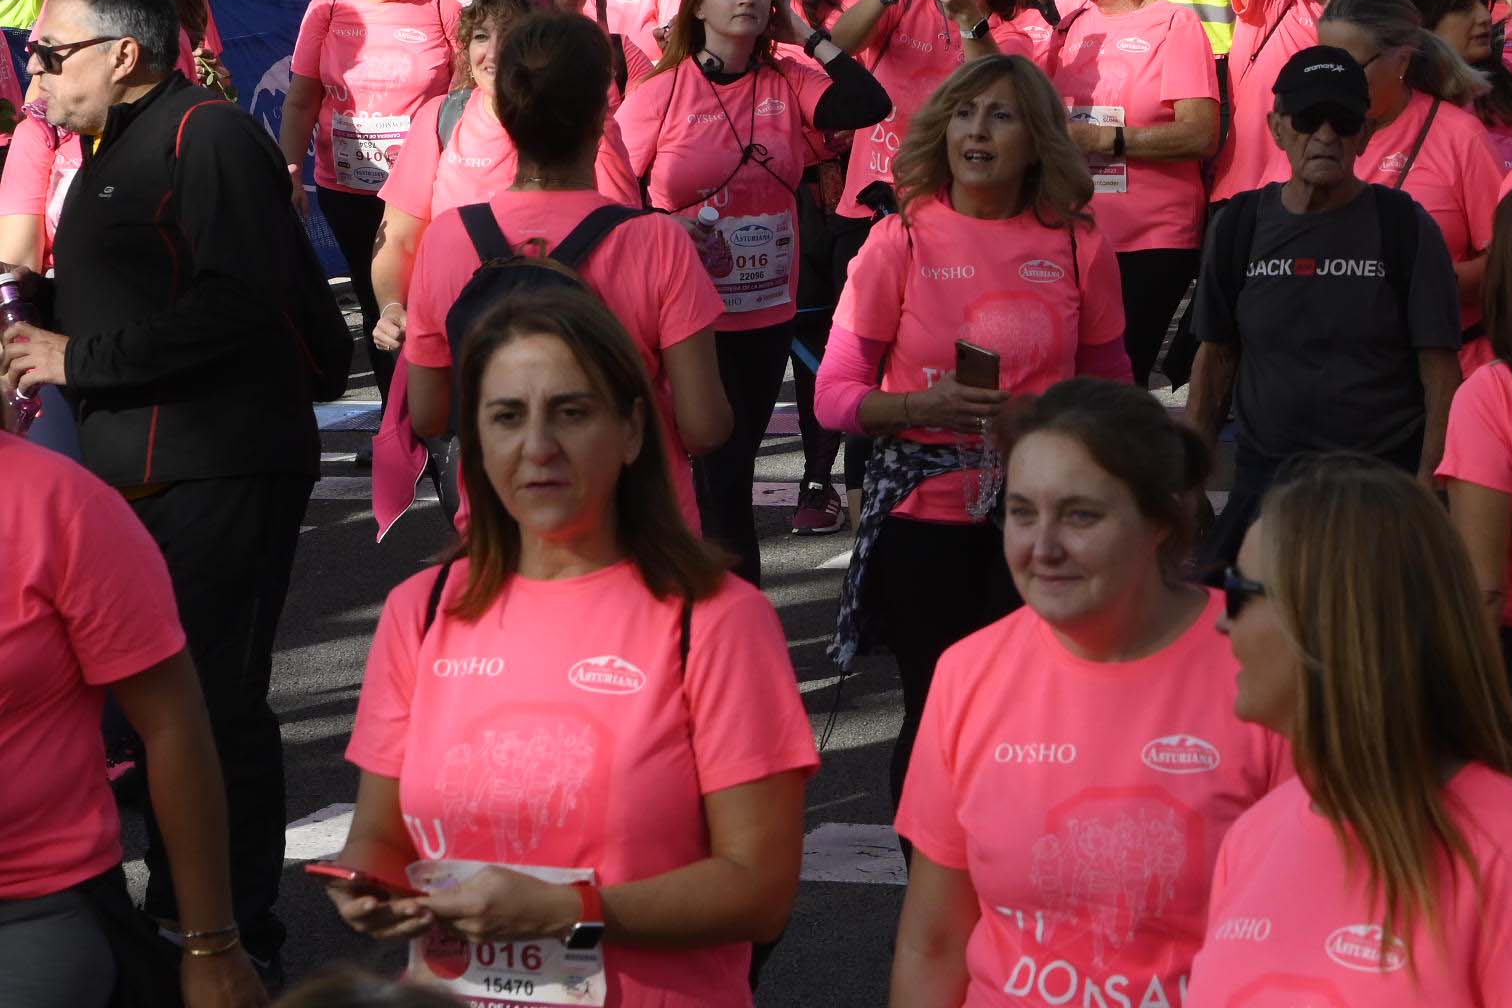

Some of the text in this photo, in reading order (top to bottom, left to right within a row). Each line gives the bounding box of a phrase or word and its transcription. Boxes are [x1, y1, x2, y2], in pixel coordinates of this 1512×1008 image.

[355, 150, 382, 162] 016
[736, 253, 769, 269] 016
[1247, 258, 1294, 278] JACK
[1315, 258, 1386, 278] JONES
[739, 271, 765, 282] 22096
[920, 264, 975, 281] OYSHO
[995, 742, 1077, 765] OYSHO
[476, 941, 544, 971] 016
[483, 976, 534, 997] 15470
